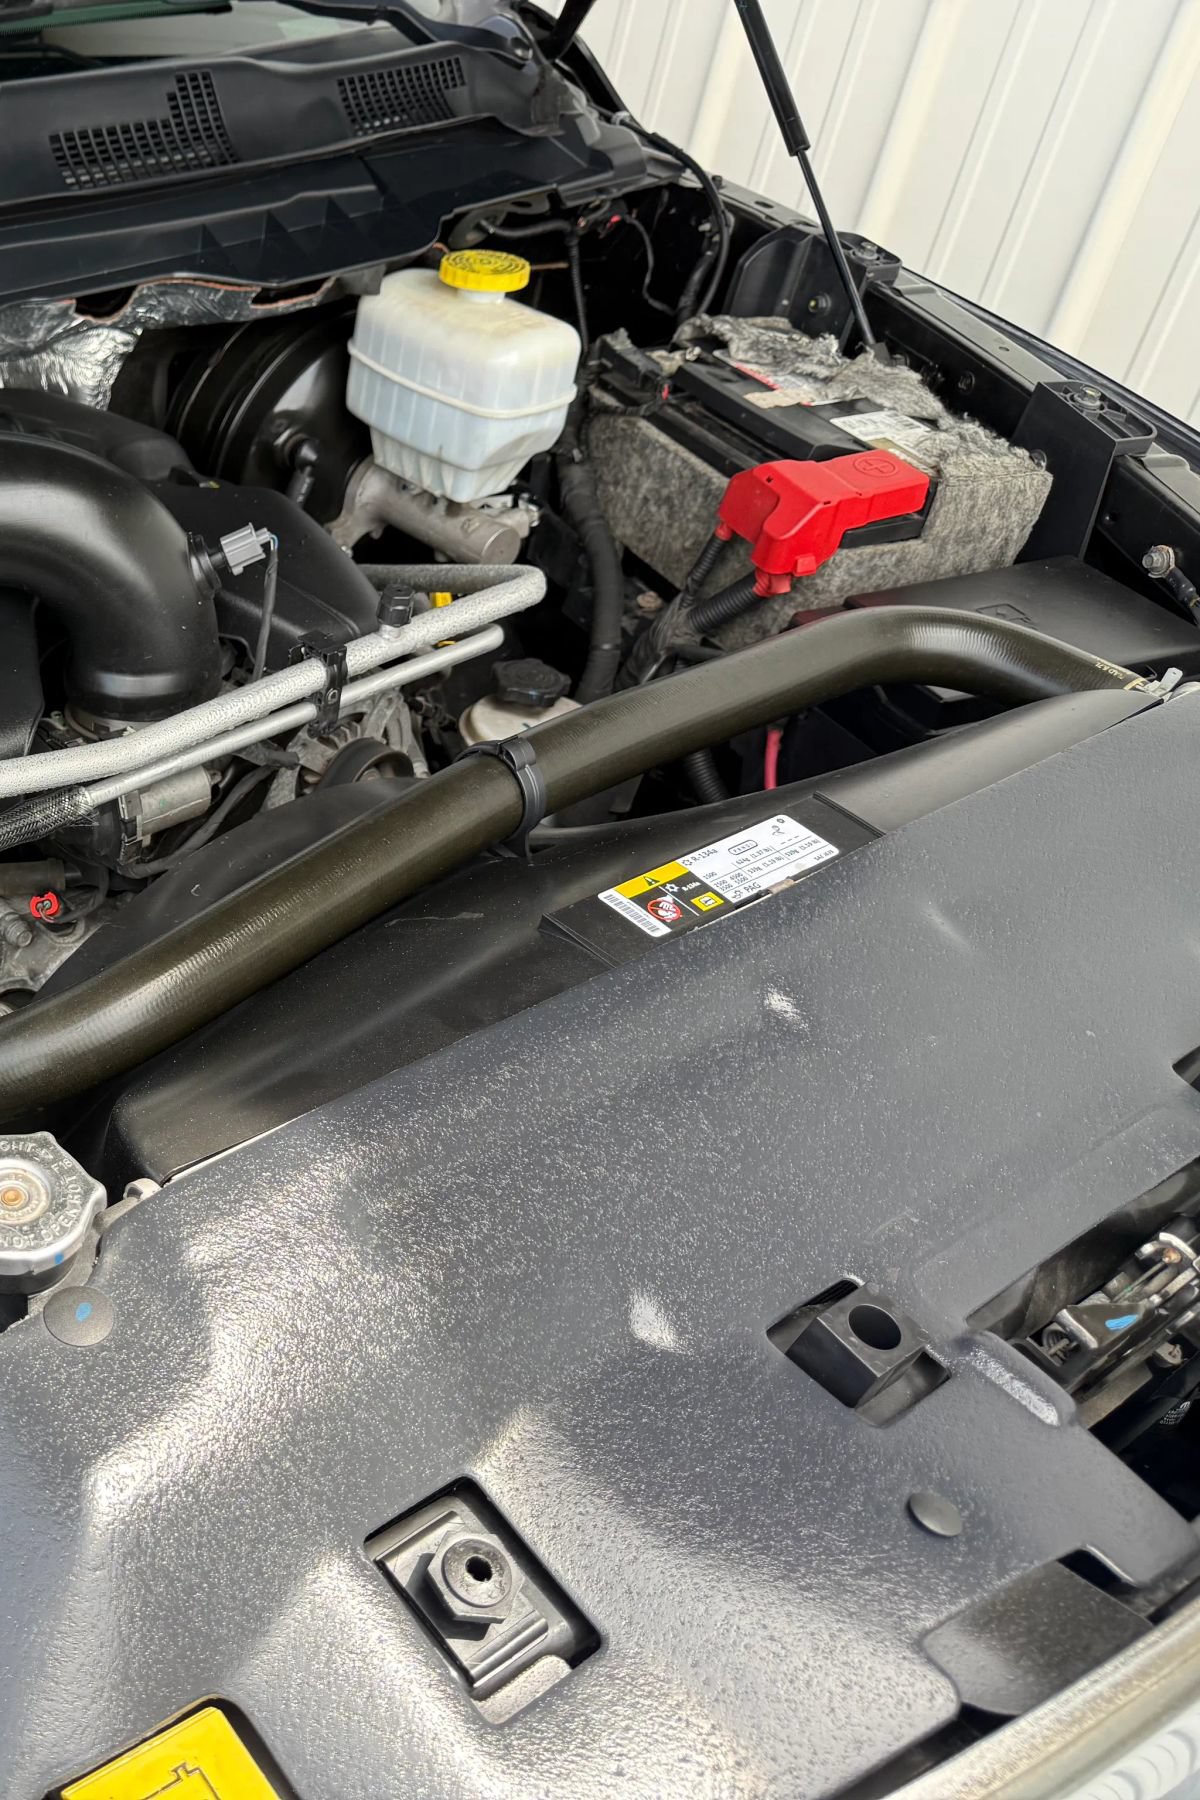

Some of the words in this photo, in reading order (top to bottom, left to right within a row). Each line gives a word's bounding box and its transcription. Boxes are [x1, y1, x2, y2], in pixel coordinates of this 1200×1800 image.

[691, 849, 718, 862] R-134a
[743, 881, 761, 893] PAG
[41, 1207, 81, 1241] OPEN
[65, 1175, 81, 1202] HOT
